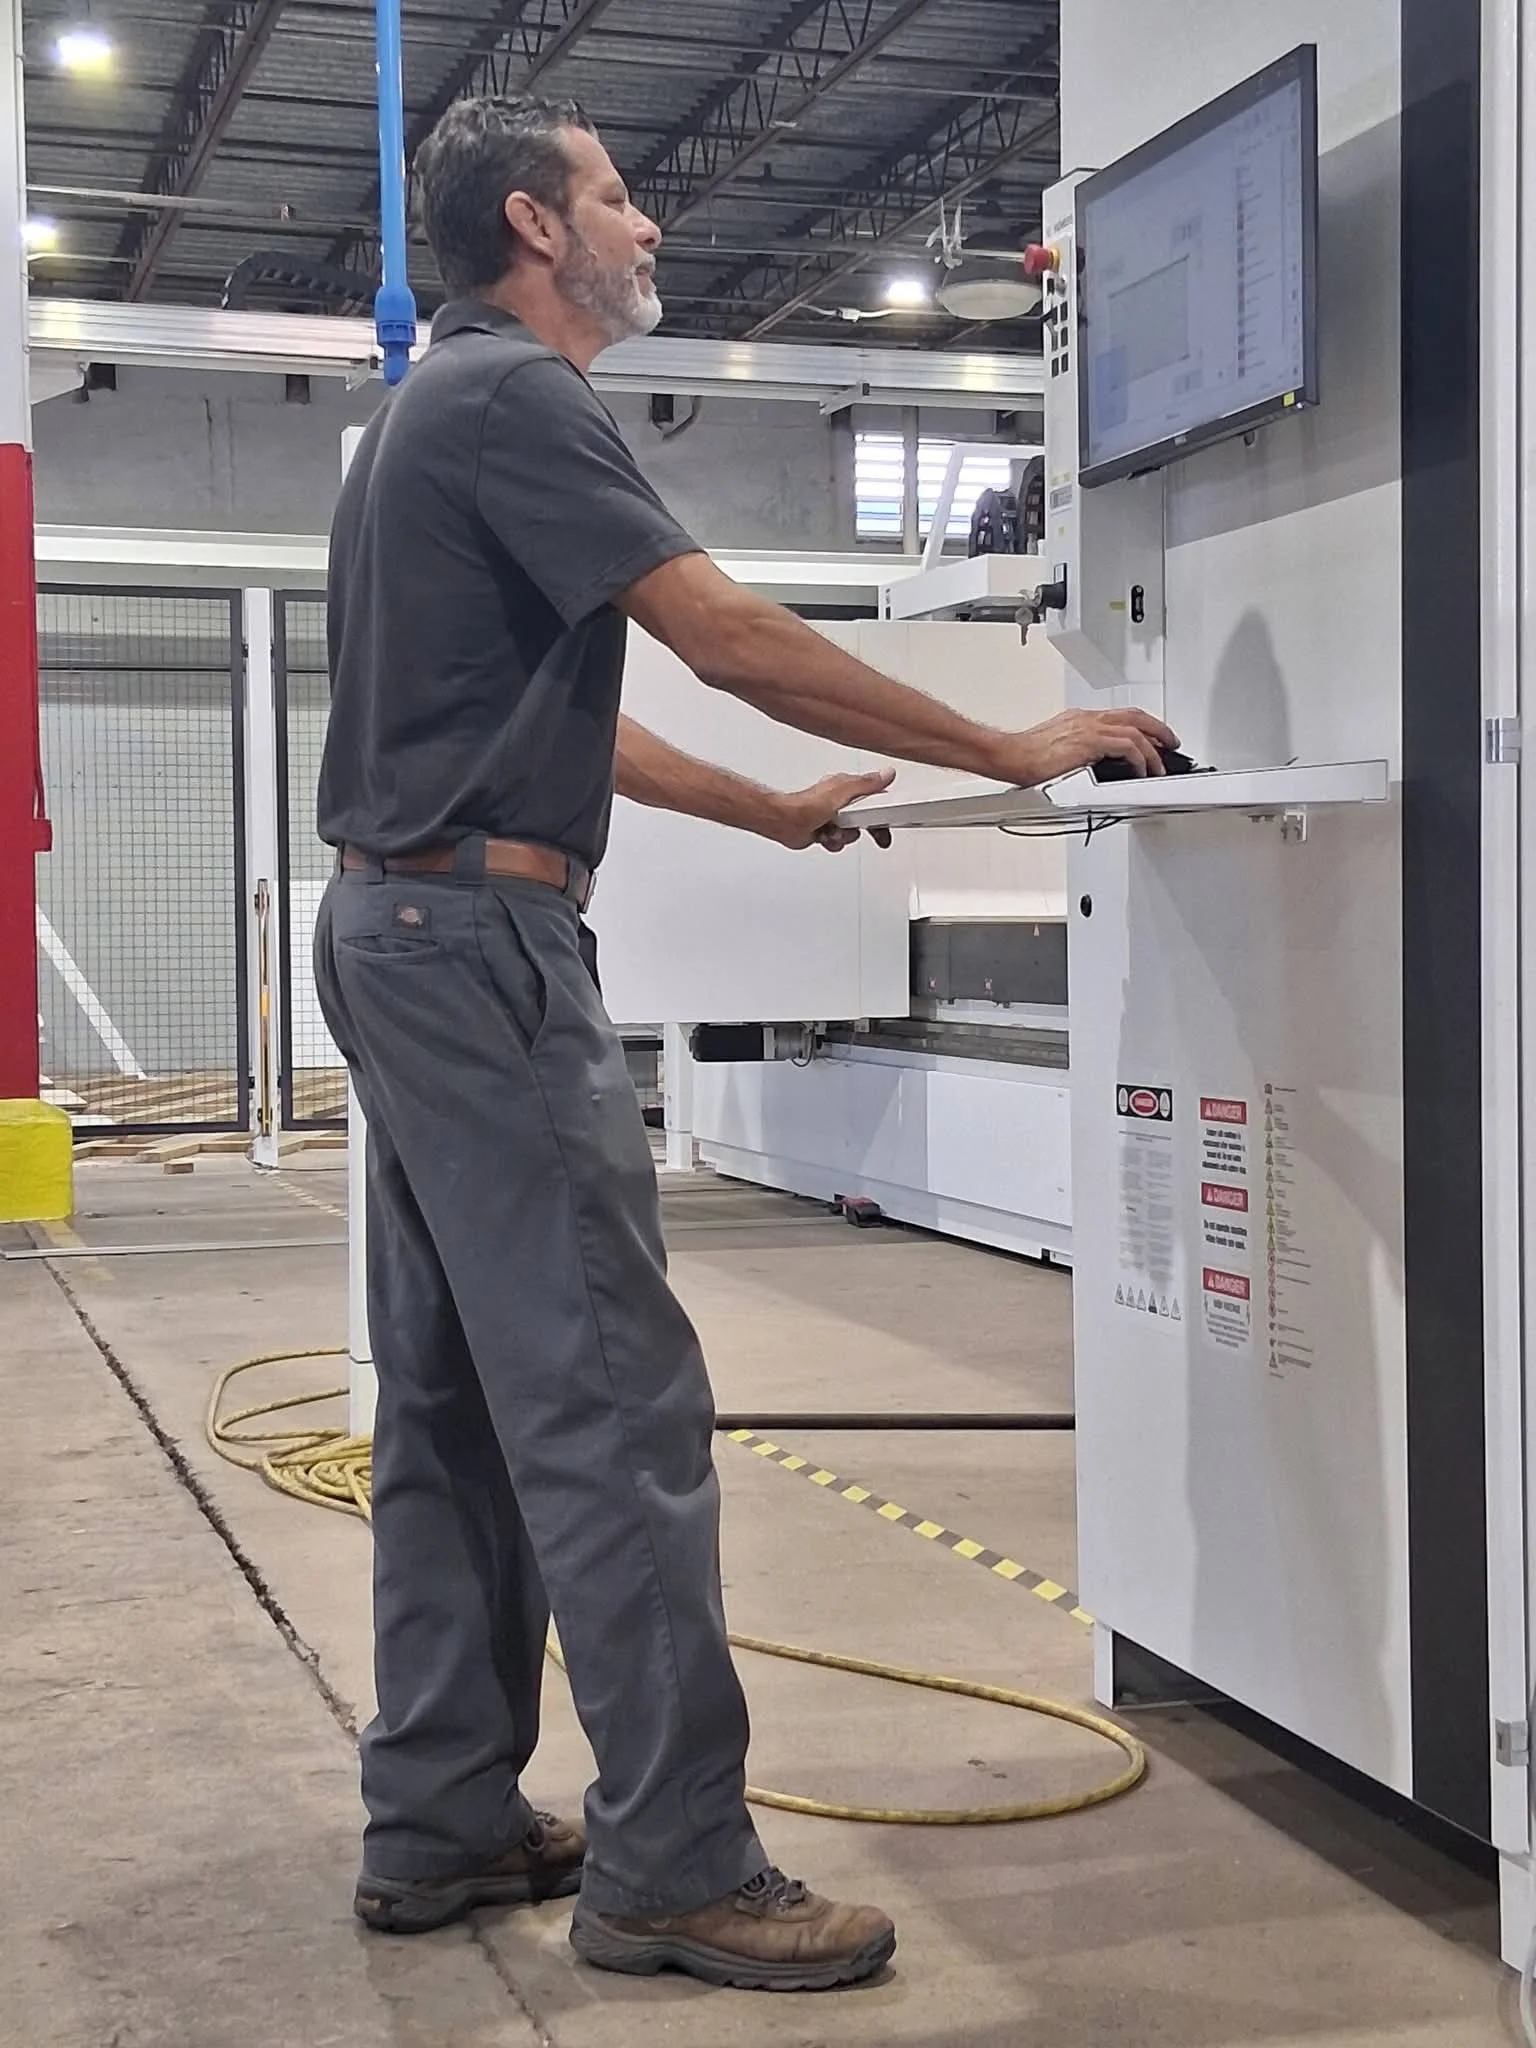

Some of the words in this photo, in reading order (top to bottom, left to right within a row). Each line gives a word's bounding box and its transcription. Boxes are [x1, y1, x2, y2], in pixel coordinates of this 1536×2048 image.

[1212, 1102, 1242, 1119] DANGER
[1213, 1187, 1244, 1208] DANGER
[1215, 1273, 1246, 1296] DANGER
